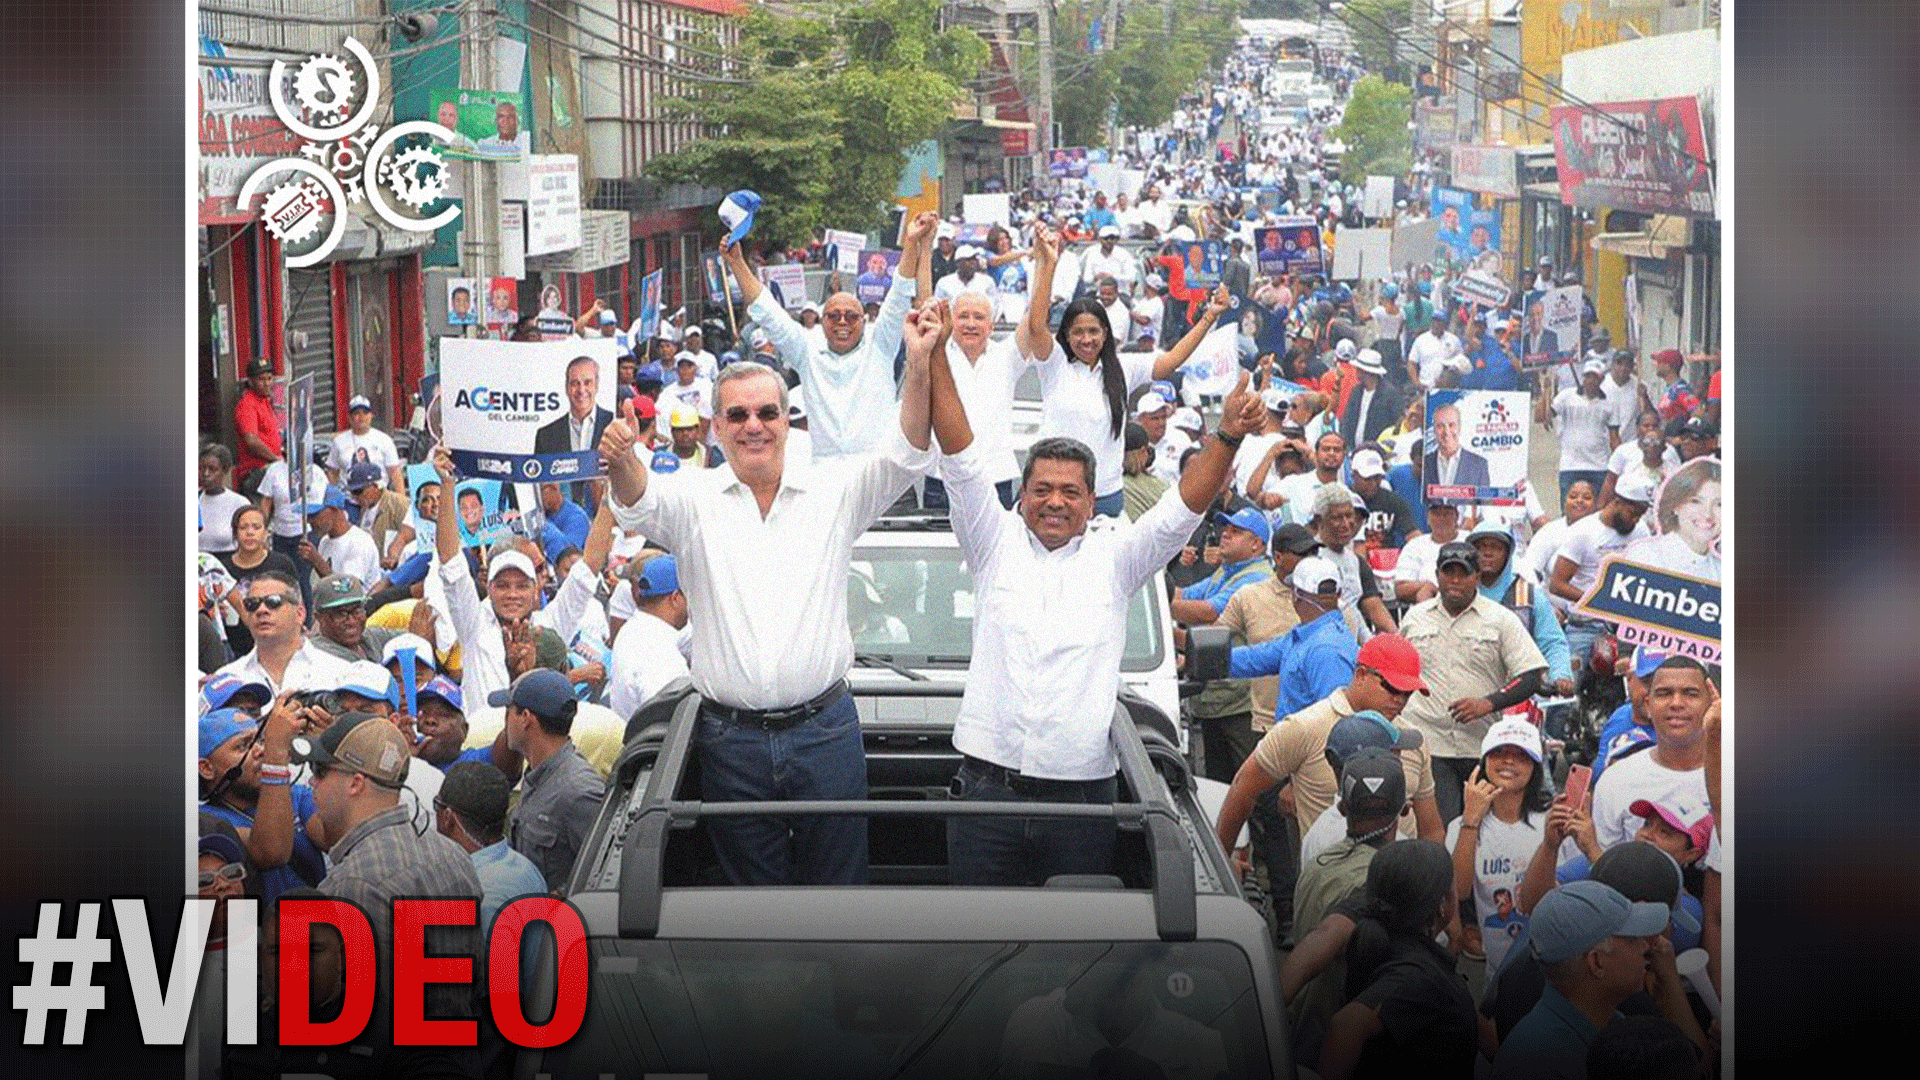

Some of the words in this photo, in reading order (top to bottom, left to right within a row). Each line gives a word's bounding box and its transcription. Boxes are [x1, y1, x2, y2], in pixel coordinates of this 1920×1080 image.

[454, 386, 560, 412] AGENTES
[488, 412, 503, 422] DEL
[505, 413, 540, 423] CAMBIO
[1471, 434, 1523, 448] CAMBIO
[1610, 572, 1721, 626] Kimbe
[1482, 857, 1511, 875] LUIS
